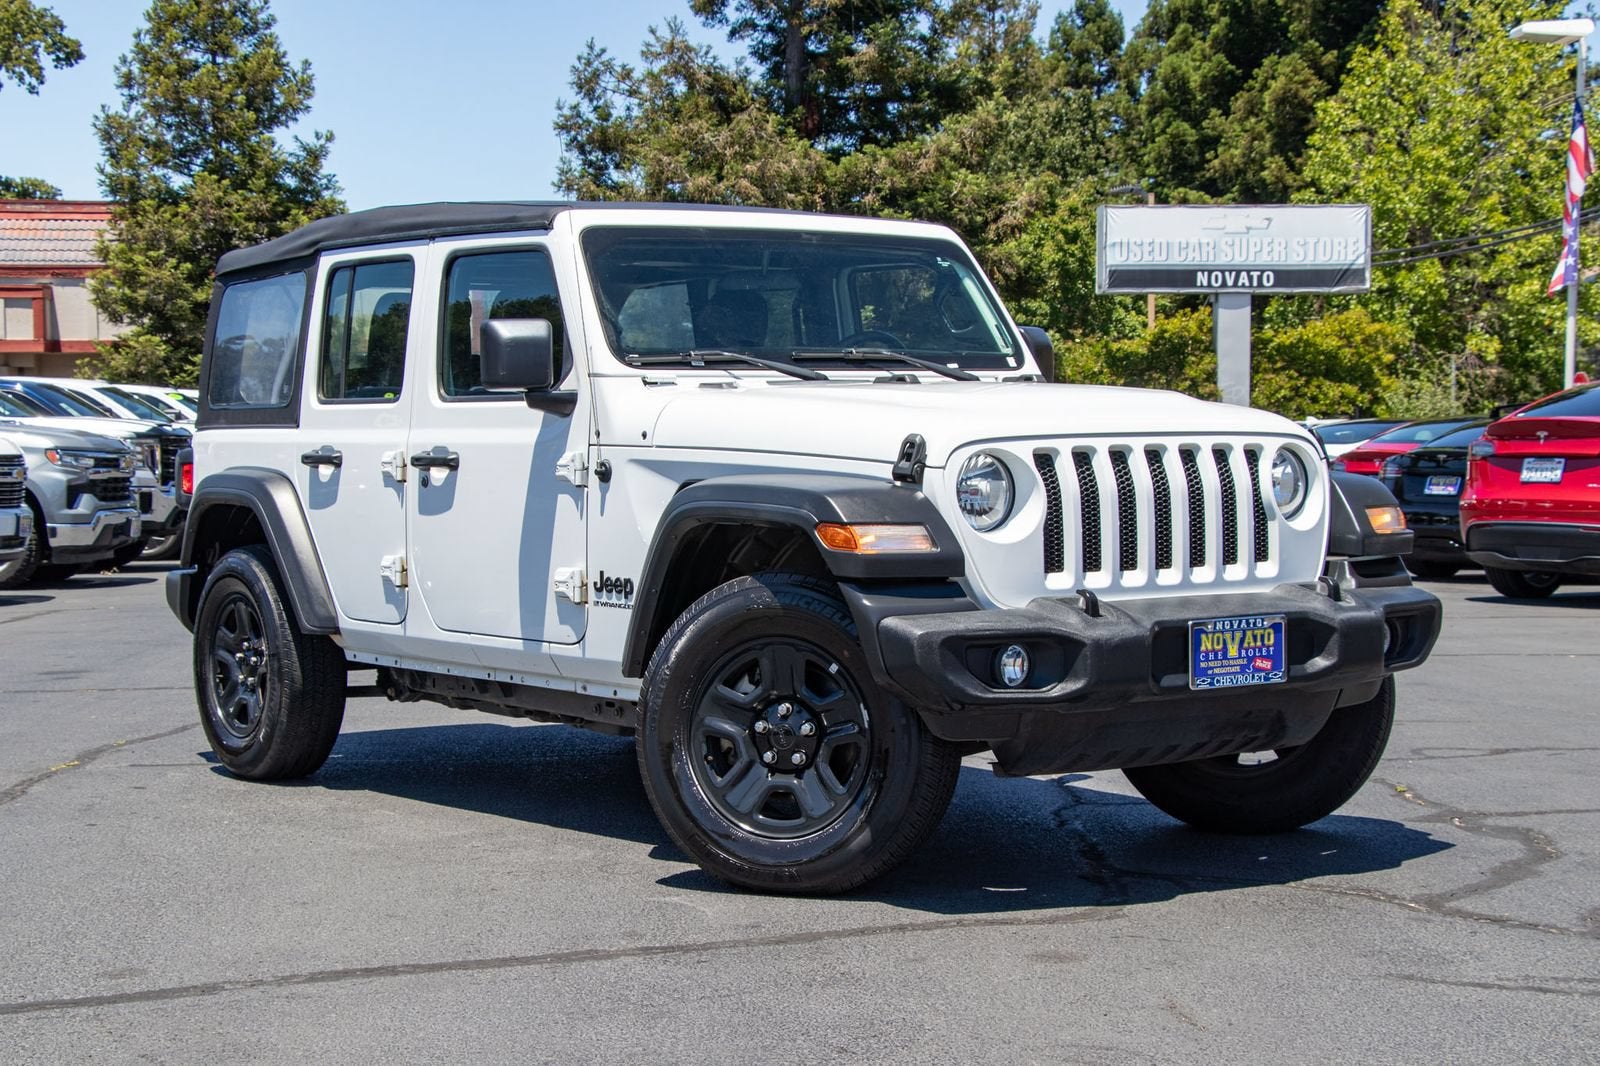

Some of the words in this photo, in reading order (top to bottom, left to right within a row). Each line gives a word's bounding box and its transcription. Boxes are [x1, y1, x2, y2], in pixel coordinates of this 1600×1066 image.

[1116, 238, 1167, 262] USED
[1174, 237, 1216, 262] CAR
[1221, 237, 1287, 262] SUPER
[1292, 237, 1359, 261] STORE
[1196, 271, 1274, 287] NOVATO
[593, 570, 634, 599] Jeep
[1216, 619, 1262, 630] NOVATO
[1200, 628, 1274, 658] NOVATO
[1229, 658, 1247, 666] HASSLE
[1214, 673, 1265, 686] CHEVROLET
